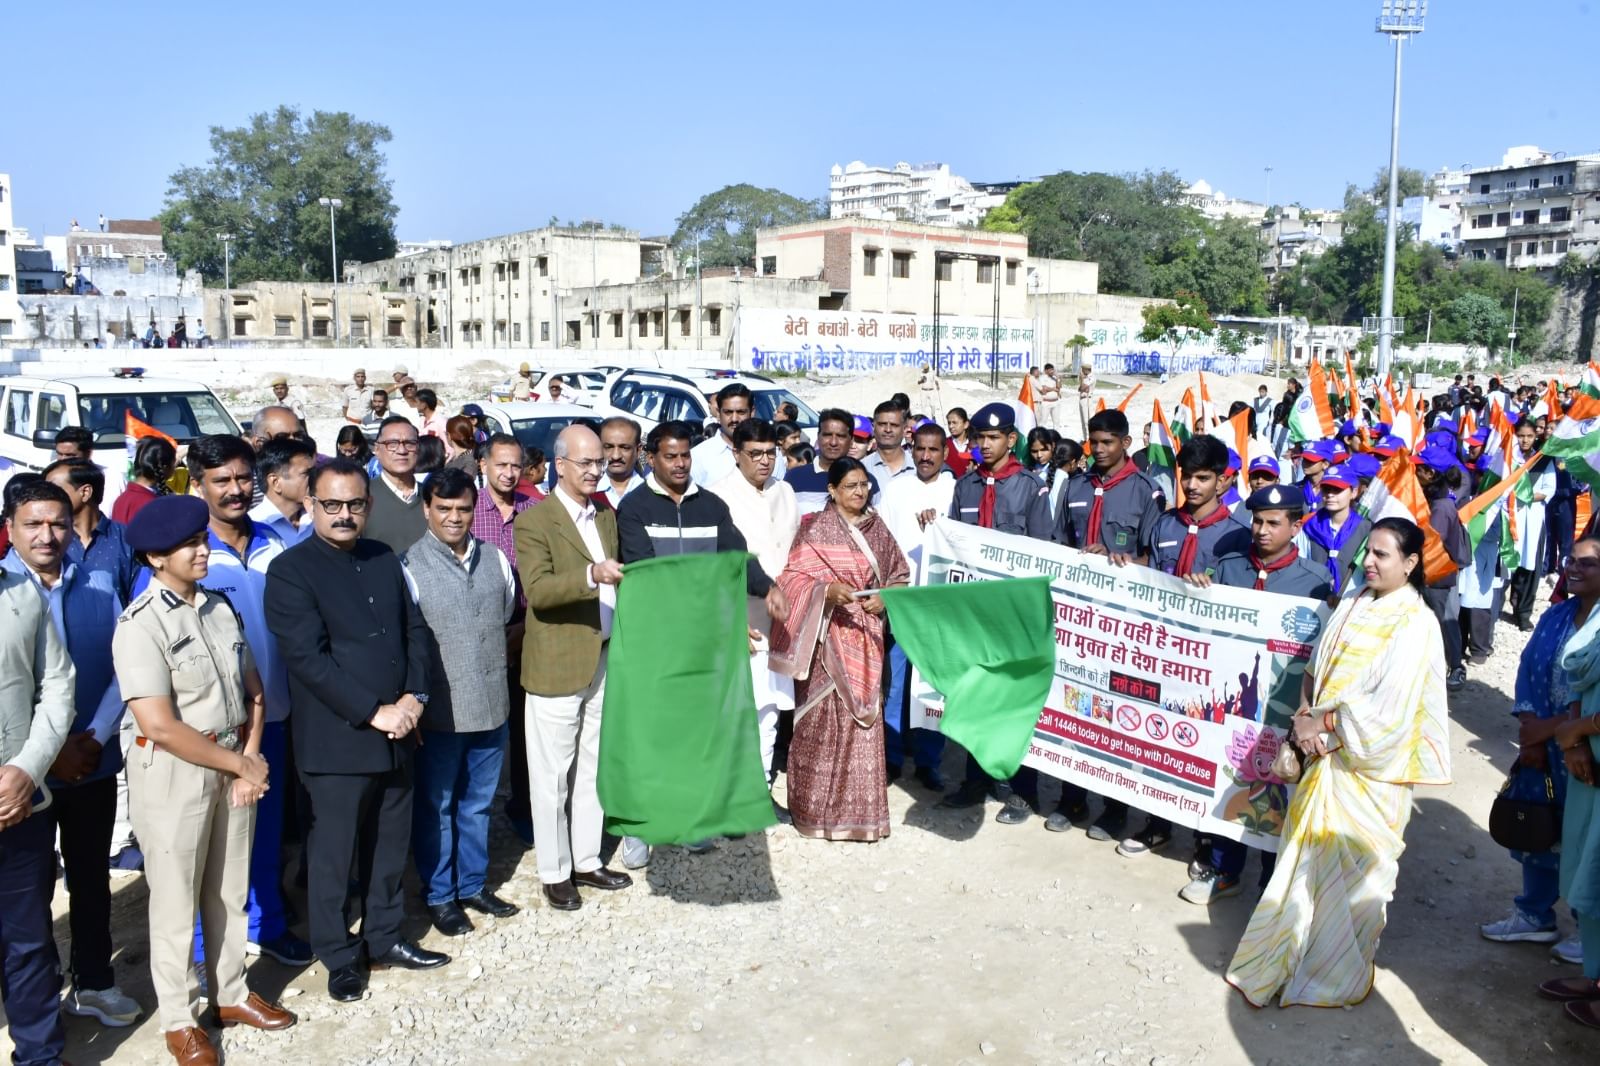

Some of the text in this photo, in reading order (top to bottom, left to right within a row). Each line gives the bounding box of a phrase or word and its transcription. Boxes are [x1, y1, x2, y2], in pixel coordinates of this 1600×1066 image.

[784, 315, 808, 336] बेटी
[818, 317, 849, 336] बचाओ
[857, 318, 878, 338] बेटी
[888, 319, 916, 341] पढ़ाओ
[958, 346, 982, 370] मेरी
[980, 543, 1005, 563] नशा
[1006, 549, 1033, 571] मुक्त
[1034, 556, 1064, 578] भारत
[1065, 564, 1116, 592] अभियान
[1127, 580, 1155, 602] नशा
[1158, 588, 1188, 612] मुक्त
[1189, 596, 1260, 626] राजसमन्द
[1098, 614, 1121, 636] का
[1124, 622, 1154, 646] यही
[1156, 624, 1168, 649] है
[1171, 634, 1211, 660] नारा
[1059, 659, 1086, 680] जिन्दगी
[1087, 668, 1098, 682] को
[1129, 678, 1144, 696] को
[1144, 685, 1158, 700] ना
[1074, 633, 1109, 658] मुक्त
[1111, 642, 1128, 664] हो
[1131, 646, 1158, 673] देश
[1161, 658, 1212, 686] हमारा
[1038, 712, 1210, 780] Call 14446 today to get help with Drug abuse
[1074, 760, 1114, 782] अधिकारिता
